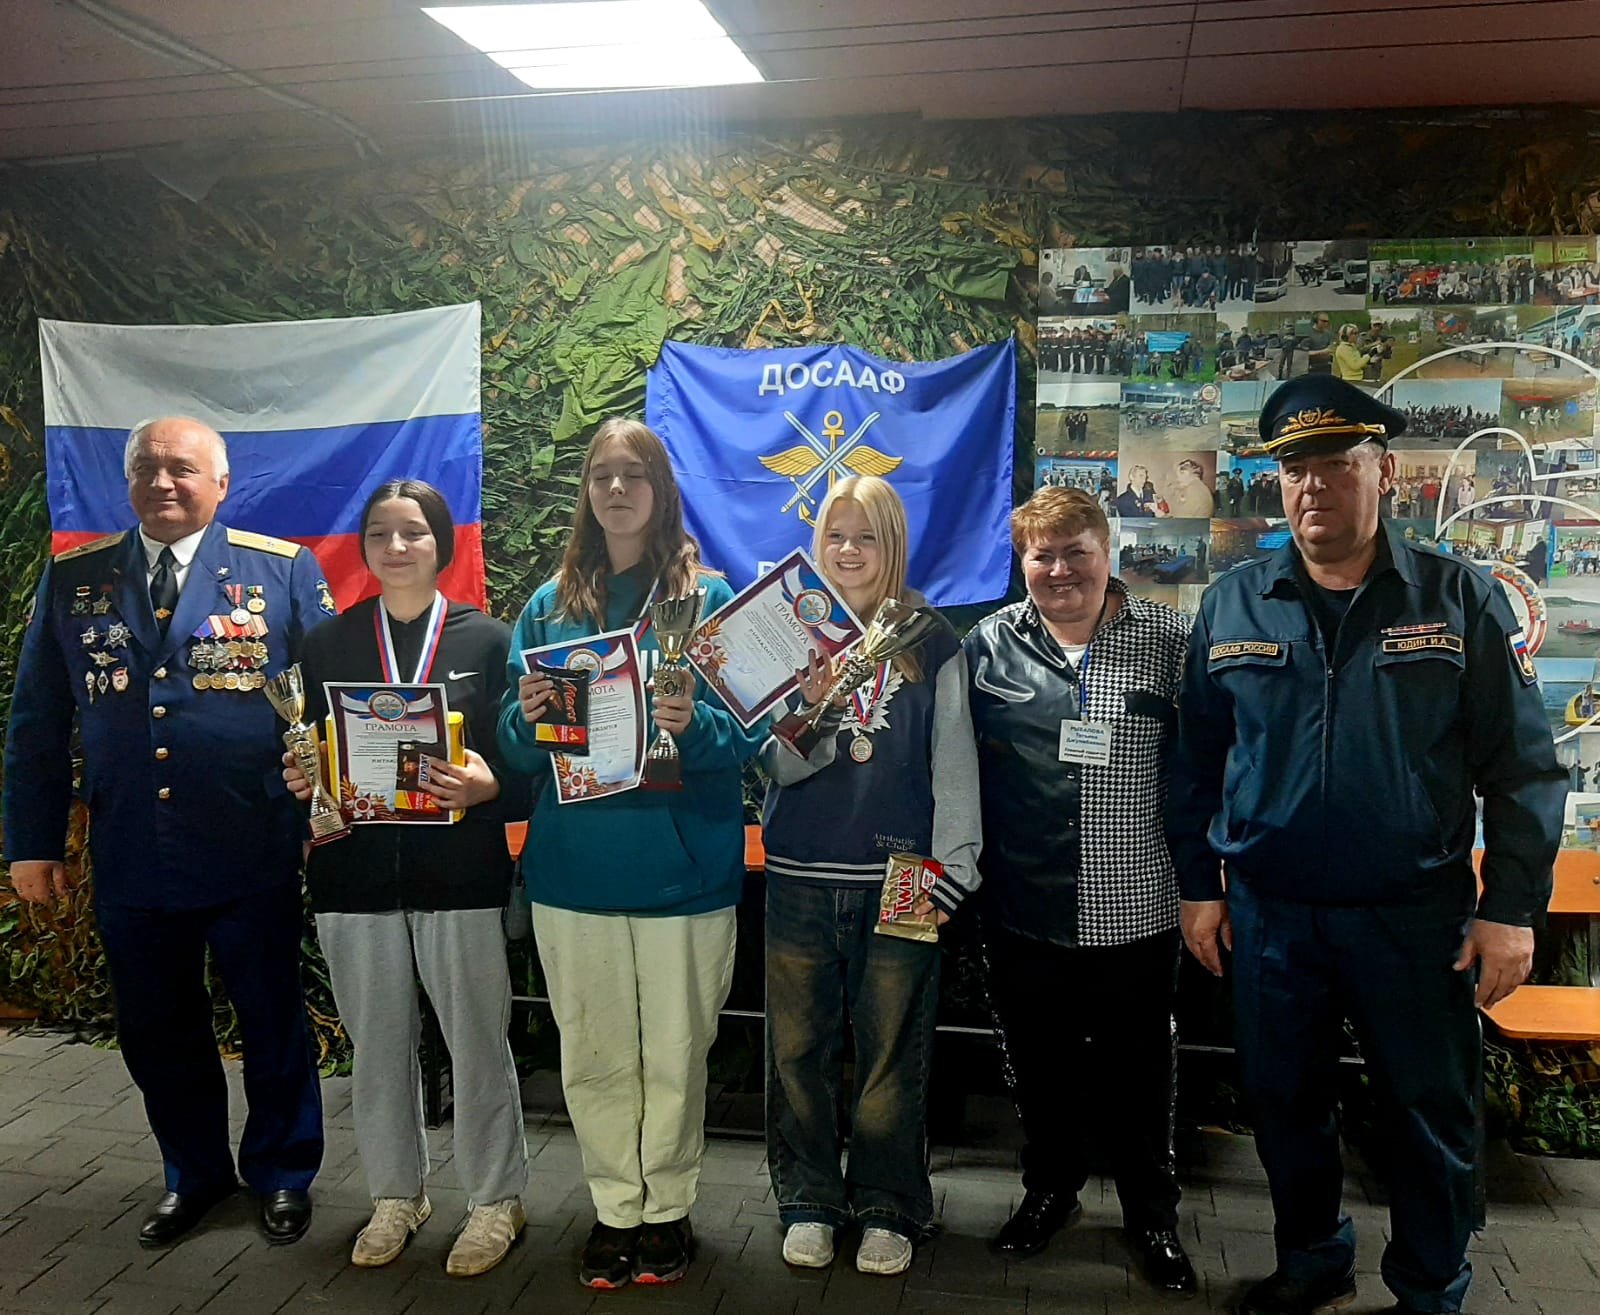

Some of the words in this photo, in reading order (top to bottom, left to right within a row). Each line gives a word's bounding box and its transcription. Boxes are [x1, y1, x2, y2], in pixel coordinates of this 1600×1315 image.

[758, 359, 906, 396] ДОСААФ
[774, 602, 809, 645] ГРАМОТА
[1243, 643, 1275, 653] РОССИИ
[1397, 639, 1426, 649] ЮДИН
[365, 722, 417, 732] ГРАМОТА
[892, 865, 914, 919] TWIX
